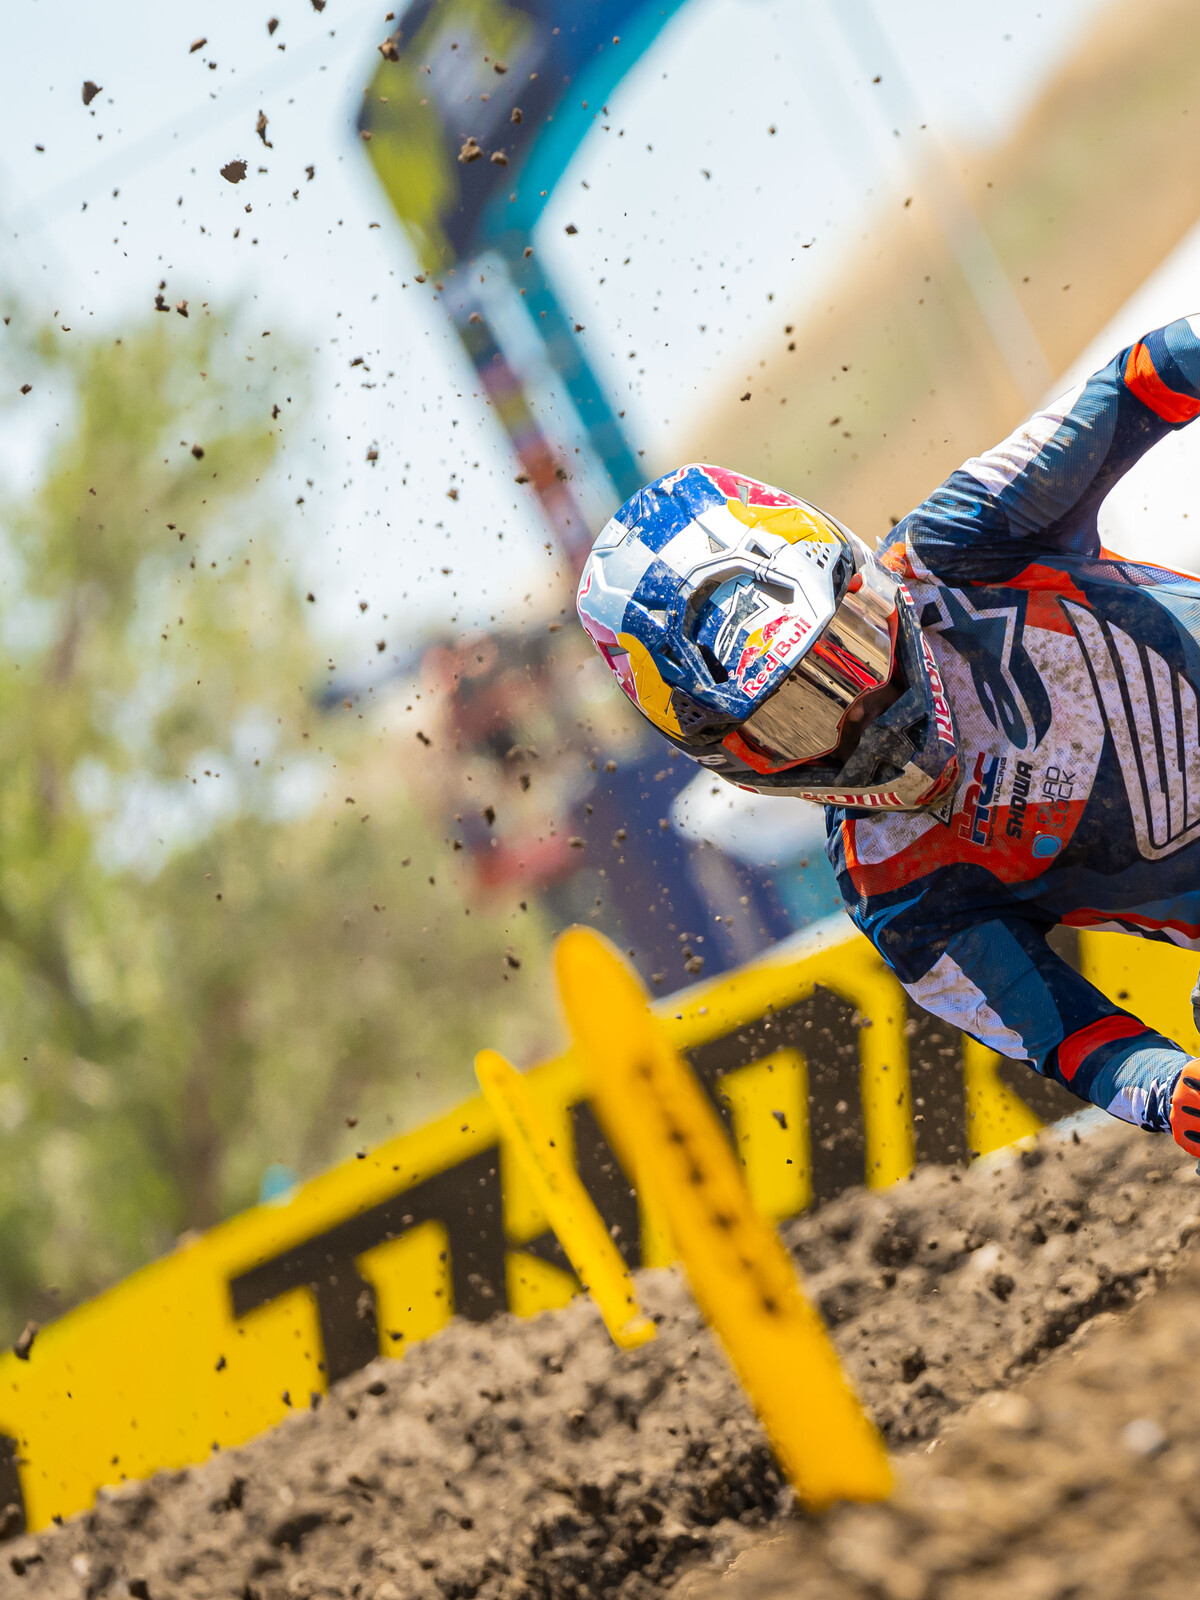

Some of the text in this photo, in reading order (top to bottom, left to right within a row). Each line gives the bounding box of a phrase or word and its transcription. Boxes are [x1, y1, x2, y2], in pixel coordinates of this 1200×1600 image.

[742, 617, 812, 699] Red Bull
[993, 757, 1007, 803] RACING
[1005, 760, 1033, 840] SHOWA
[1036, 766, 1060, 824] QUAD
[1050, 769, 1076, 828] LOCK
